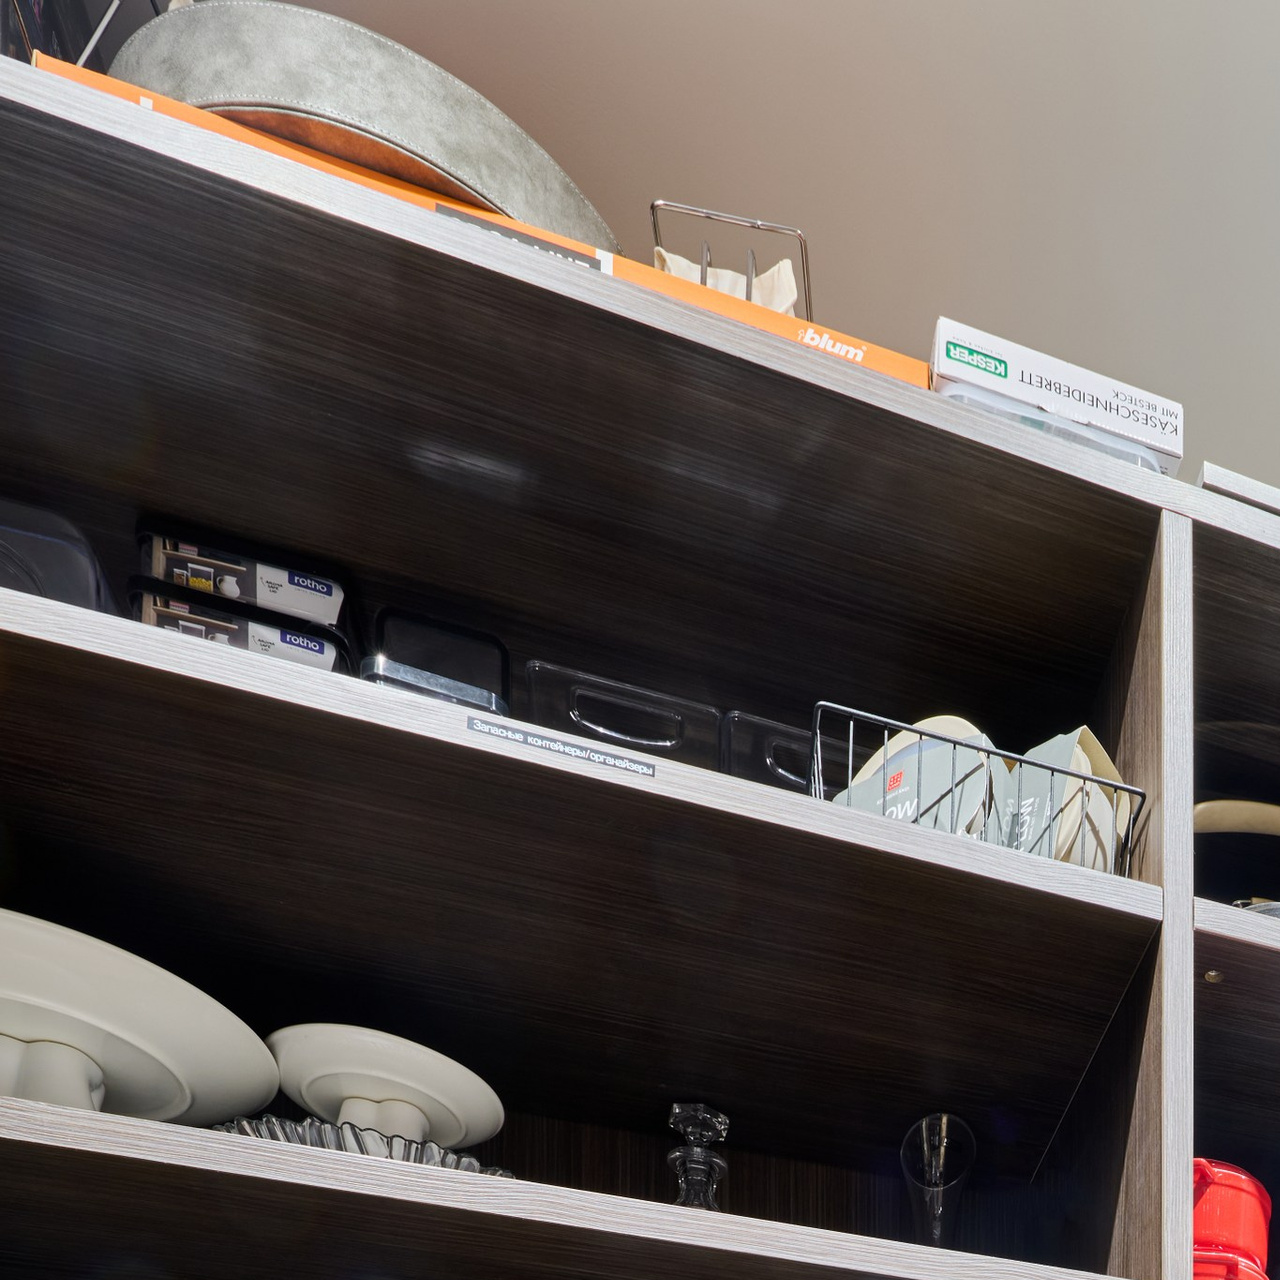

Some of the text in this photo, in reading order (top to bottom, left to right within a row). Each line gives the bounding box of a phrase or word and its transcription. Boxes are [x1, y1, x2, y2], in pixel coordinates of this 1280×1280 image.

[802, 328, 864, 362] blum
[949, 344, 1006, 377] KESPER
[1018, 369, 1179, 437] KÄSESCHNEIDEBRETT
[1111, 388, 1179, 420] MIT BESTECK
[294, 575, 327, 592] rotho
[286, 633, 319, 650] rotho
[473, 719, 524, 742] Запасные
